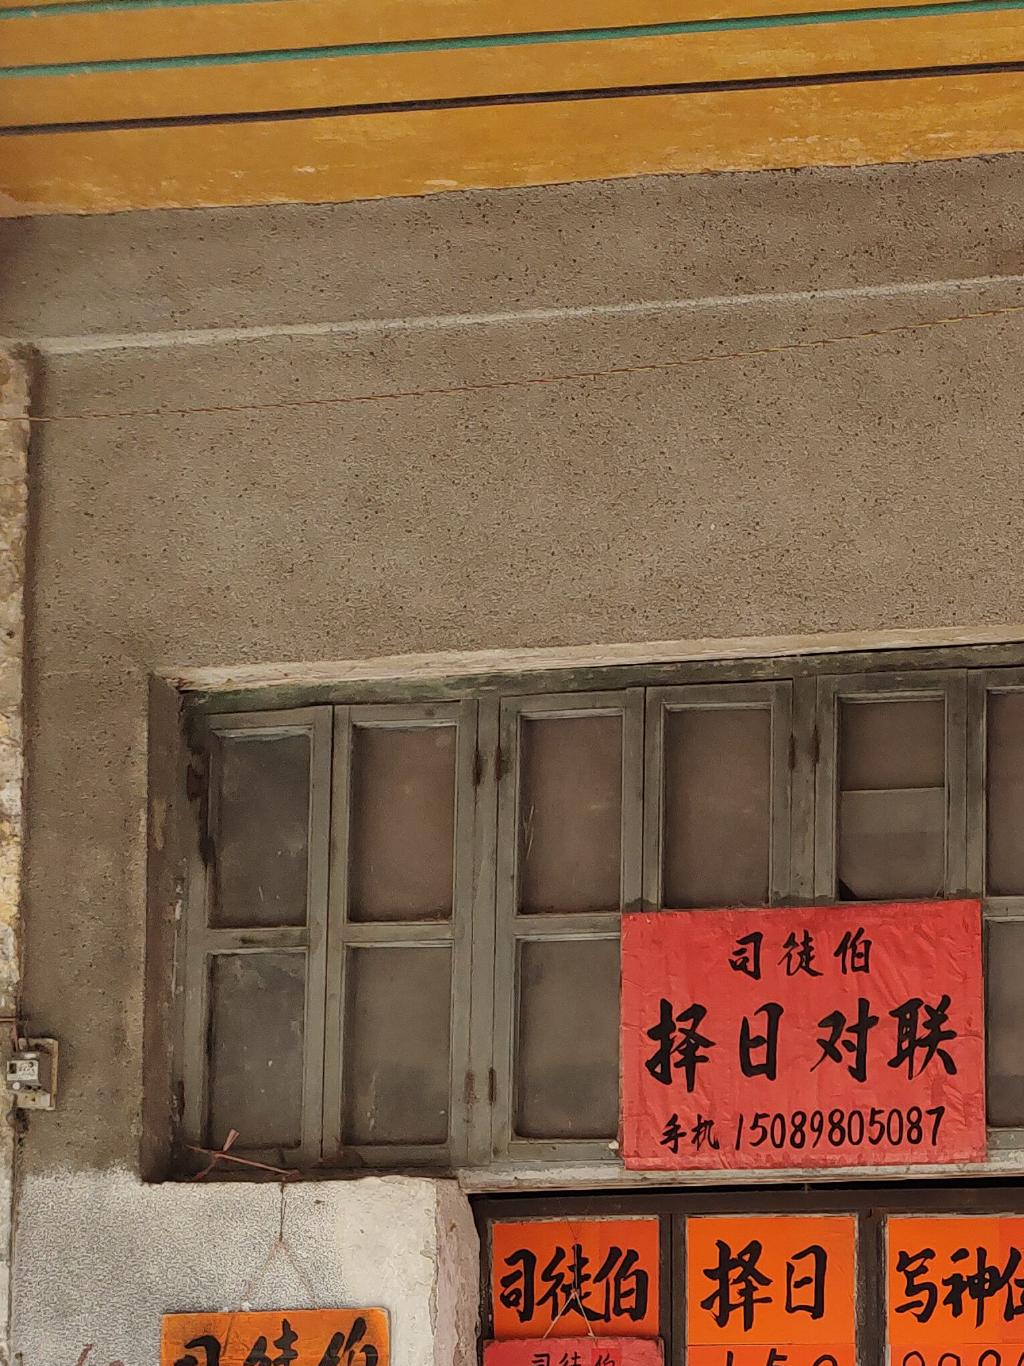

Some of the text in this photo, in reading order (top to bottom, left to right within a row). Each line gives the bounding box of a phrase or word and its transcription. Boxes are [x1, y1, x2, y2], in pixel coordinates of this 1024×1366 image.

[728, 927, 873, 981] 司徒伯
[645, 994, 958, 1093] 择日对联
[660, 1106, 945, 1153] 手机 15089805087
[498, 1244, 649, 1324] 司徒伯
[700, 1239, 828, 1332] 择日
